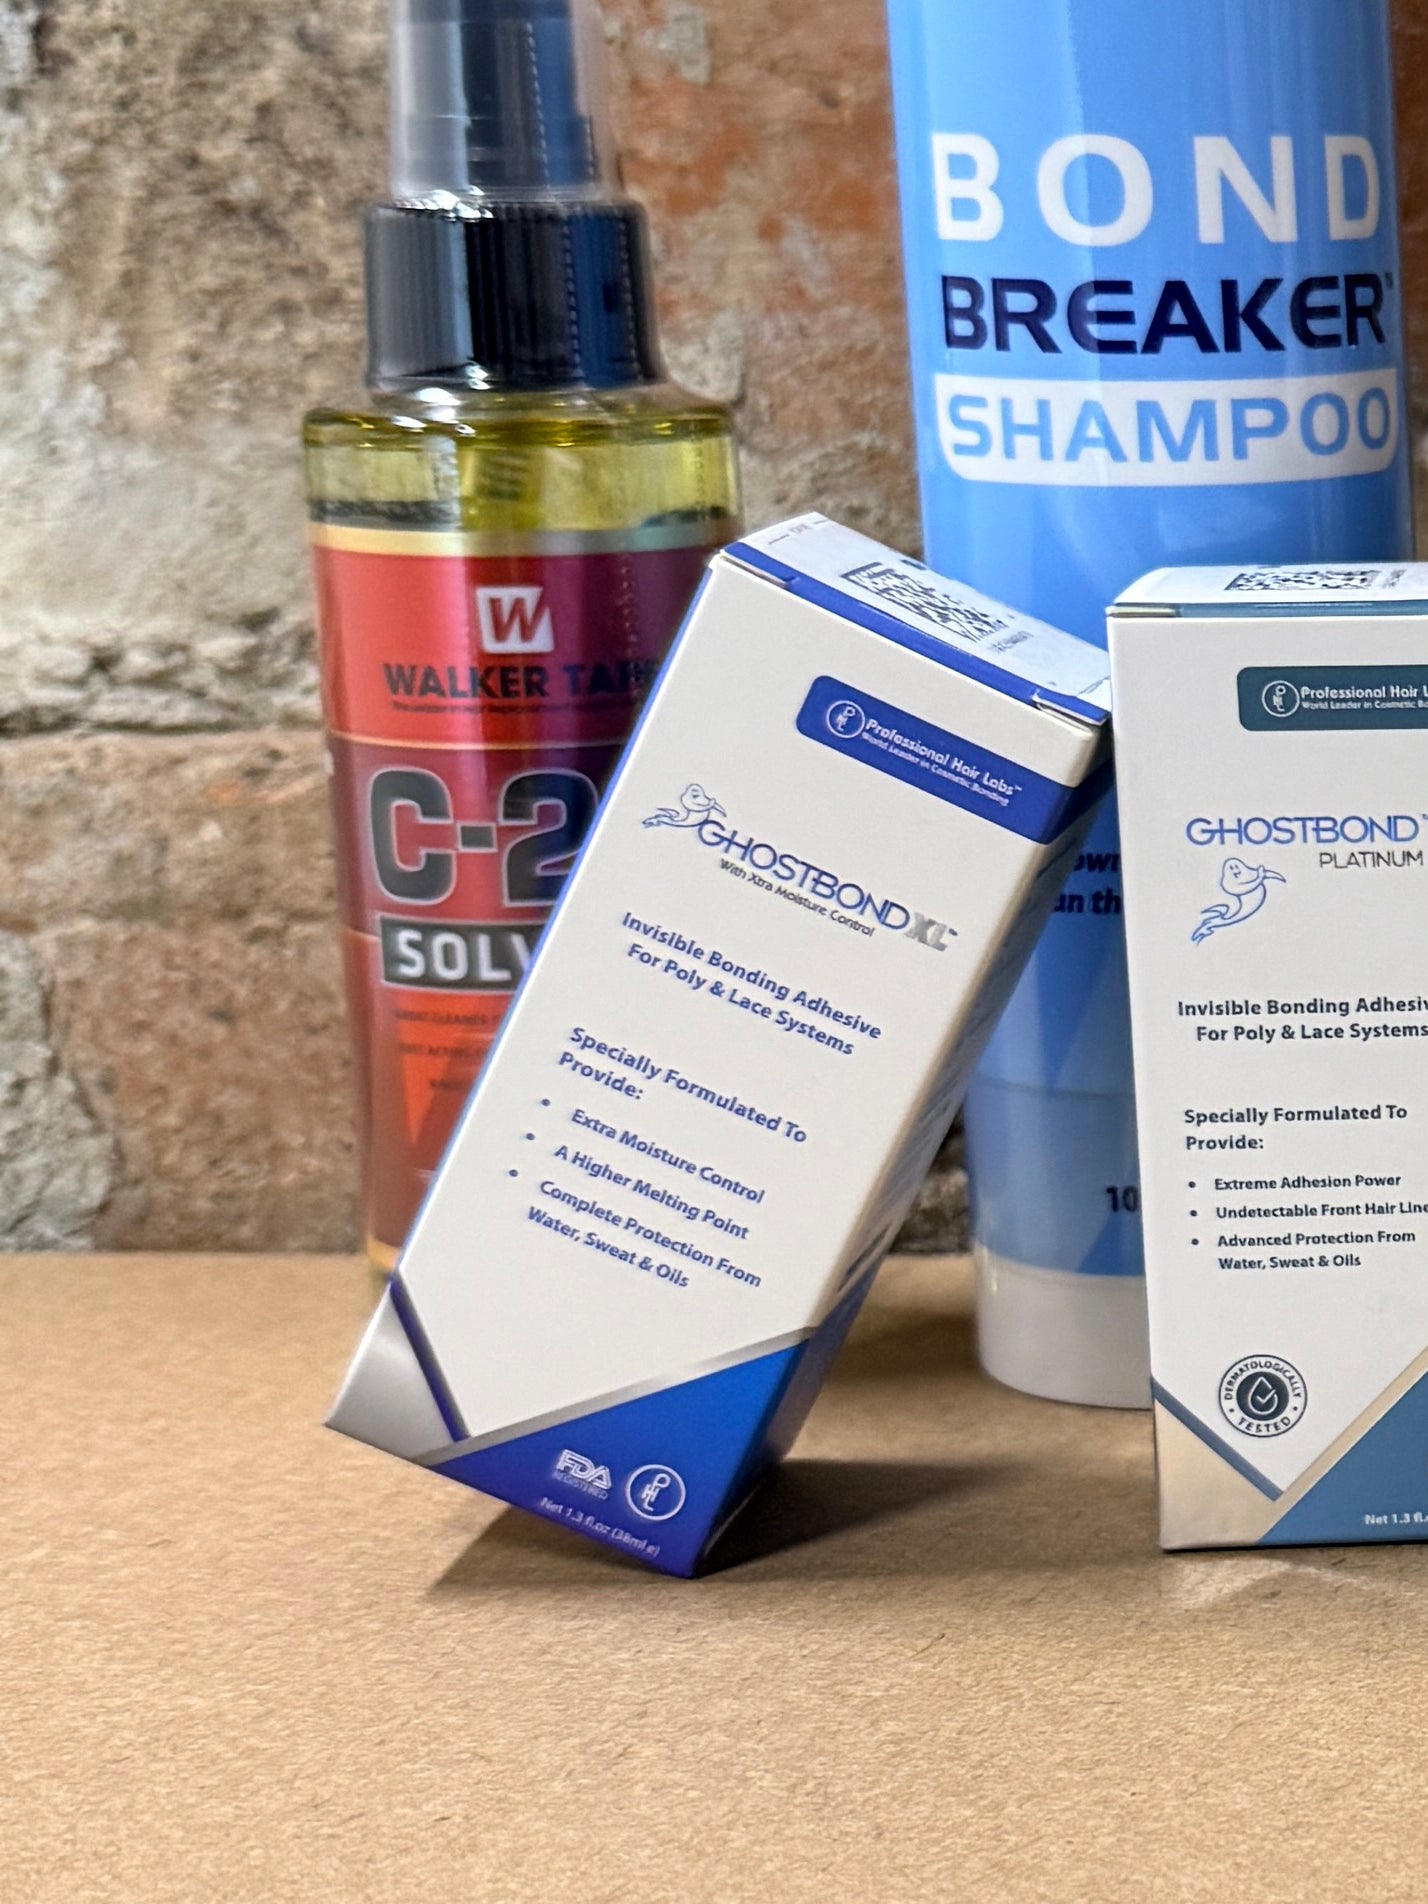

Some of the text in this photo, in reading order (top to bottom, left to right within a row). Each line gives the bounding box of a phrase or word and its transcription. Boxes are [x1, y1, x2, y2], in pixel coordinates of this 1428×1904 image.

[931, 132, 1381, 247] BOND
[940, 273, 1386, 354] BREAKER
[947, 387, 1391, 463] SHAMPOO
[381, 662, 549, 698] WALKER
[1301, 685, 1418, 699] Professional Hair
[865, 718, 980, 780] Professional Hair
[1319, 850, 1424, 870] PLATINUM
[774, 884, 875, 937] Moisture Control
[622, 911, 882, 1039] Invisible Bonding Adhesive
[627, 942, 855, 1056] For Poly & Lace Systems
[1177, 999, 1262, 1016] Invisible
[1267, 998, 1350, 1016] Bonding
[1196, 1026, 1228, 1041] For
[1233, 1025, 1276, 1043] Poly
[1280, 1025, 1296, 1040] &
[1300, 1024, 1345, 1039] Lace
[557, 1051, 644, 1100] Provide:
[569, 1026, 808, 1143] Specially Formulated To
[1184, 1104, 1408, 1127] Specially Formulated To
[571, 1108, 765, 1204] Extra Moisture Control
[1185, 1135, 1264, 1150] Provide:
[554, 1145, 750, 1240] A Higher Melting Point
[1214, 1175, 1402, 1191] Extreme Adhesion Power
[1216, 1205, 1318, 1219] Undetectable
[1321, 1203, 1362, 1216] Front
[1365, 1202, 1396, 1215] Hair
[528, 1206, 690, 1287] Water, Sweat Oils
[539, 1180, 762, 1287] Complete Protection From
[1217, 1231, 1416, 1247] Advanced Protection From
[1218, 1254, 1361, 1270] Water, Sweat Oils
[1224, 1360, 1302, 1400] DERMATOLOGICALLY
[1237, 1416, 1291, 1433] TESTED
[556, 1448, 612, 1490] FDA
[1364, 1513, 1388, 1526] Net
